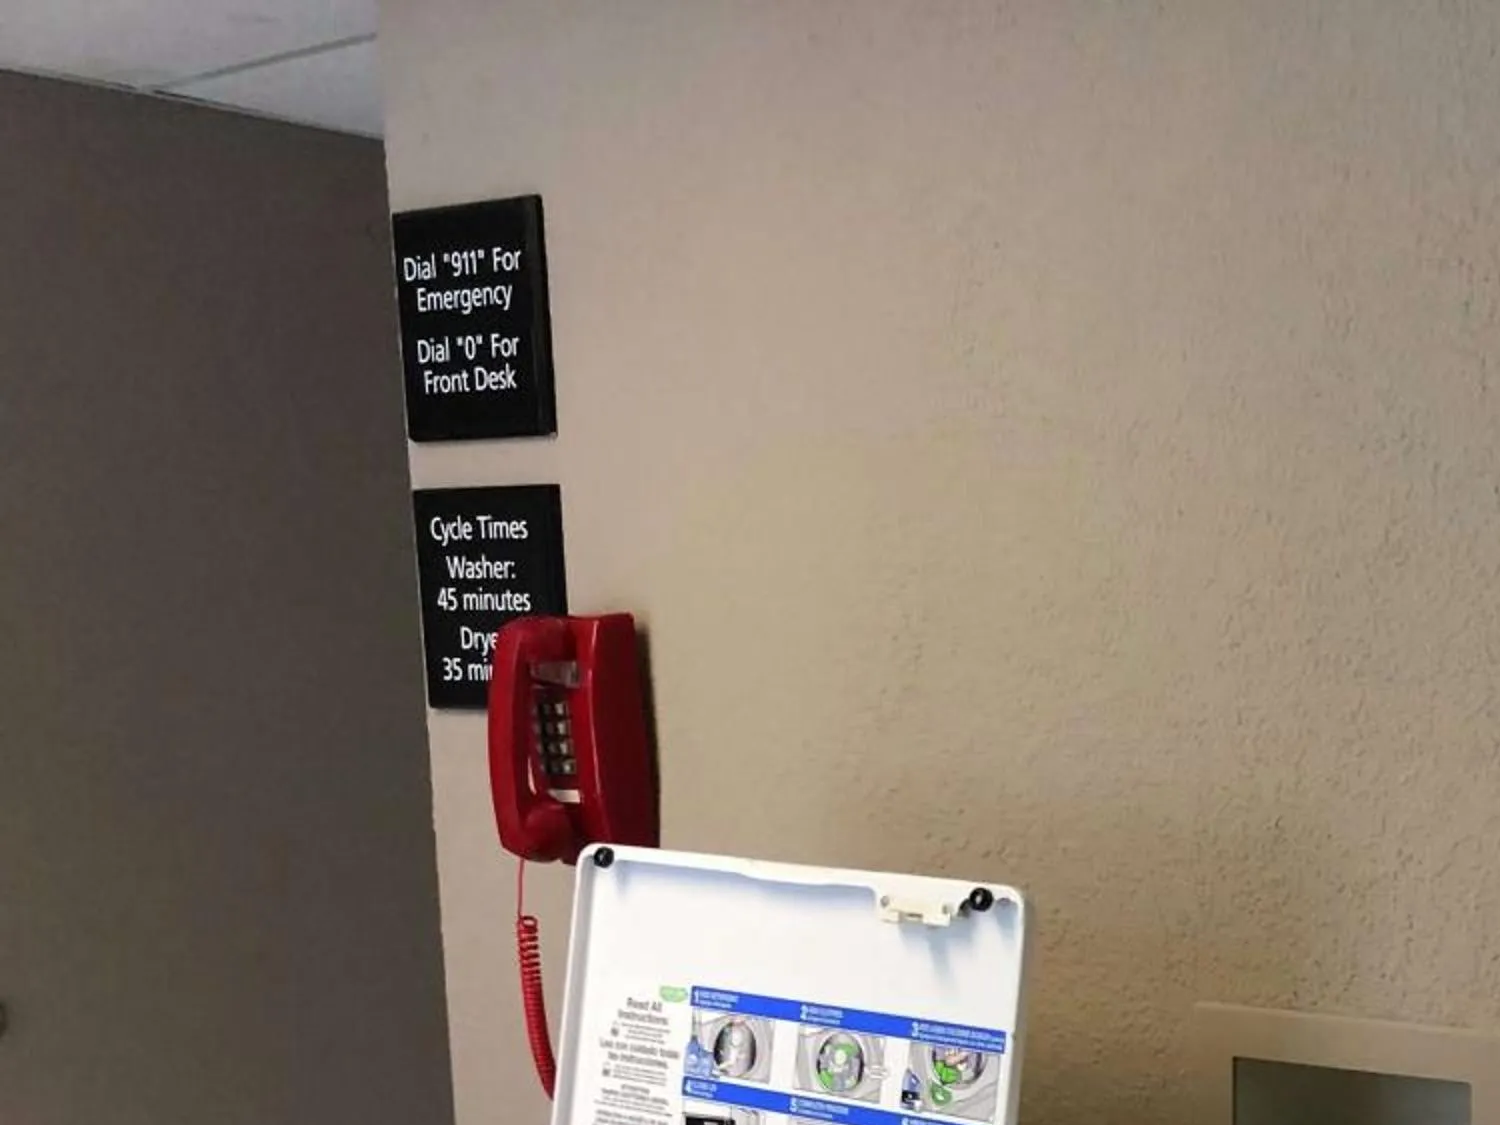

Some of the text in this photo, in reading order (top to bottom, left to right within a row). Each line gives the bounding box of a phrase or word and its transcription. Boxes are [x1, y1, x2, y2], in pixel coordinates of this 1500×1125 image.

[403, 247, 522, 282] Dial "911" For
[416, 284, 513, 315] Emergency
[417, 333, 520, 364] Dial "0" For
[423, 363, 518, 395] Front Desk
[429, 515, 529, 546] Cycle Times
[445, 553, 517, 580] Washer:
[437, 587, 532, 612] 45 minutes
[459, 626, 499, 656] Drye
[442, 656, 463, 681] 35
